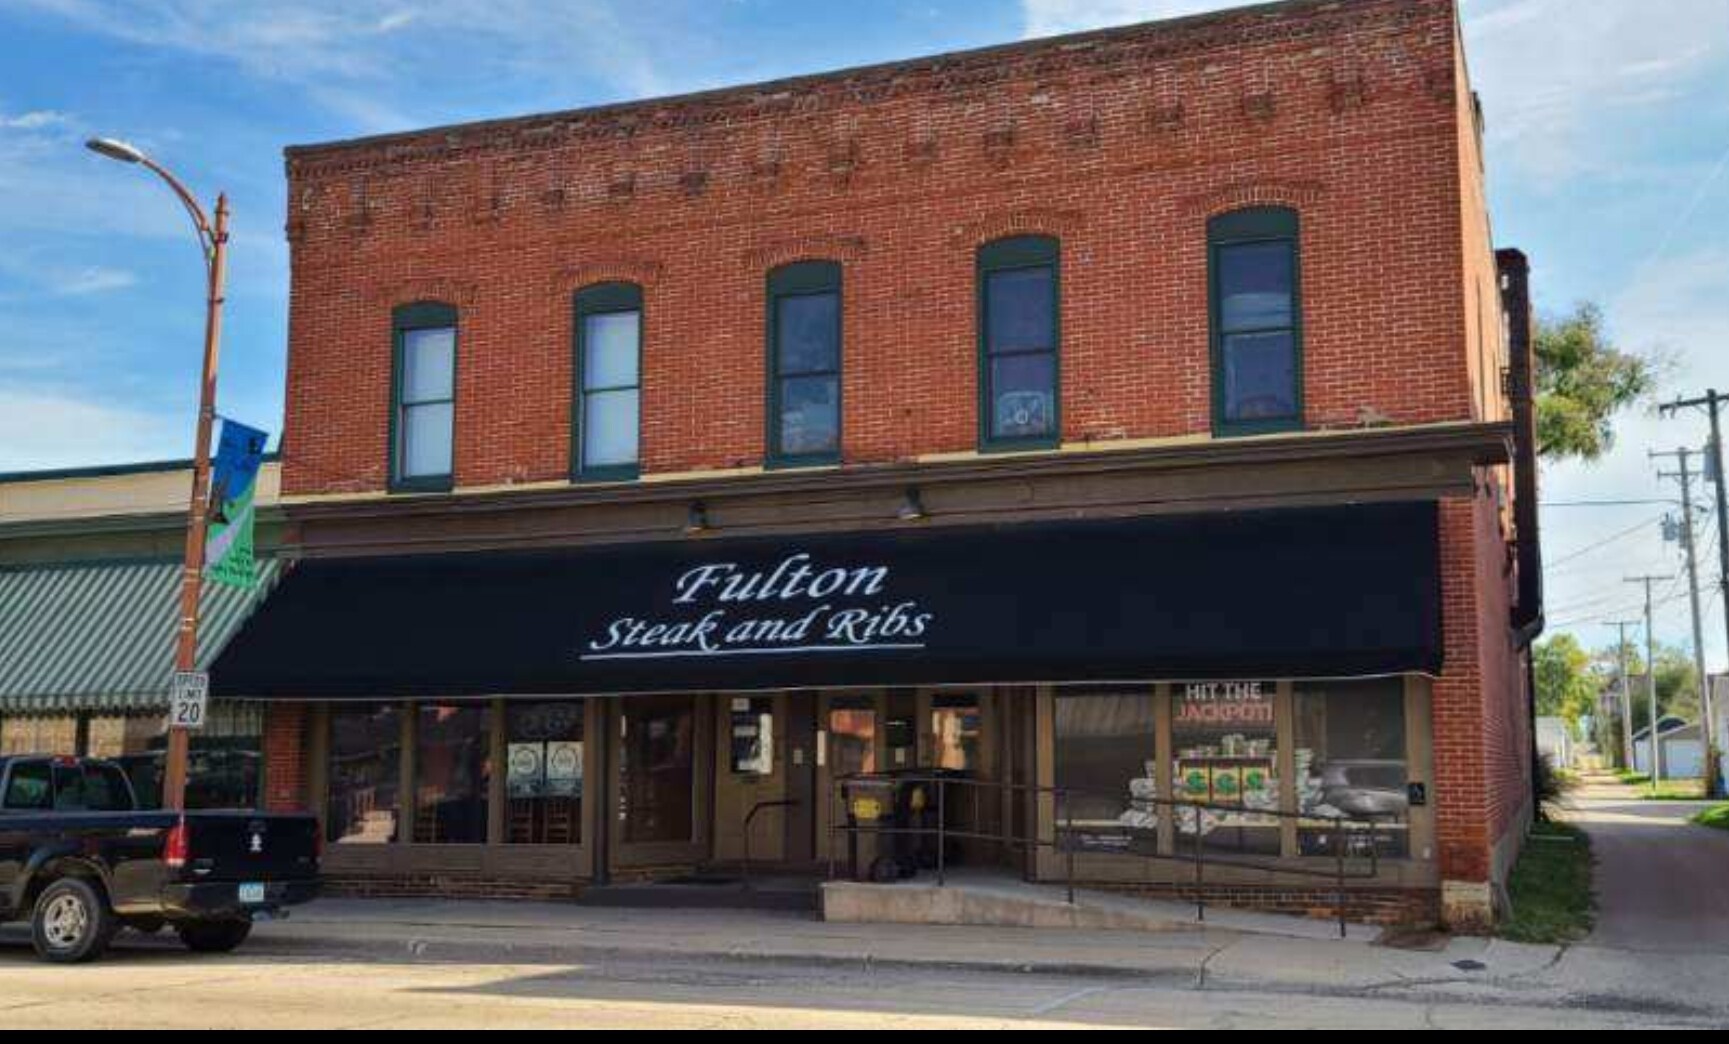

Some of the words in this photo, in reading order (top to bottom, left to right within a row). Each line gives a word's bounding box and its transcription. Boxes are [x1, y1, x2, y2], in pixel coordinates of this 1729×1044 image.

[672, 553, 889, 604] Fulton
[590, 610, 725, 651] Steak
[725, 604, 830, 643] and
[826, 602, 934, 644] Ribs
[1185, 683, 1218, 699] HIT
[1223, 682, 1262, 699] THE
[178, 702, 199, 723] 20
